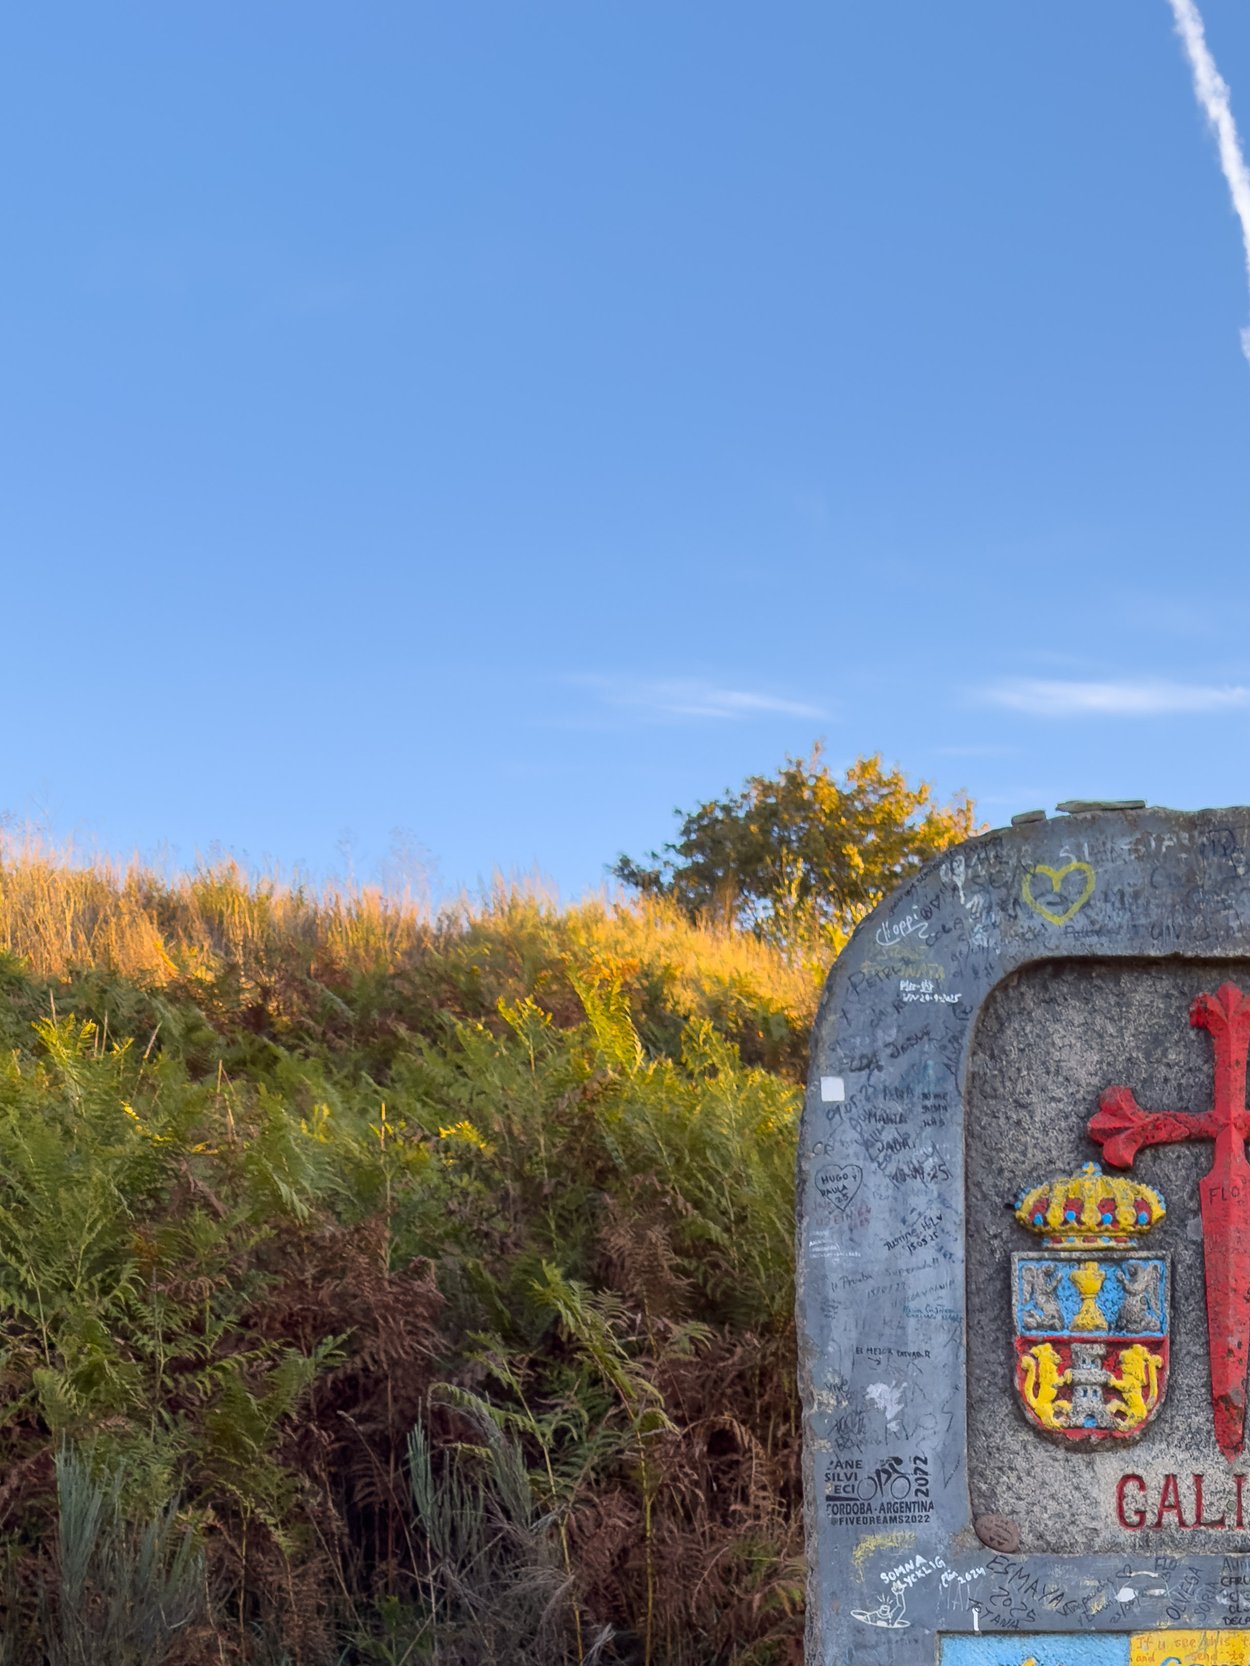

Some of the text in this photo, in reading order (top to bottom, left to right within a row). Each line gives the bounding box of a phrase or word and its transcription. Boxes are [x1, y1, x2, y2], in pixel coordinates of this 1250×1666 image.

[820, 1172, 849, 1184] HUGO
[819, 1184, 848, 1198] PAULA
[824, 1472, 858, 1482] SILVI
[879, 1500, 935, 1514] ARGENTINA
[830, 1514, 931, 1527] @FIVEDREAMS2022
[879, 1554, 928, 1585] SOMNA
